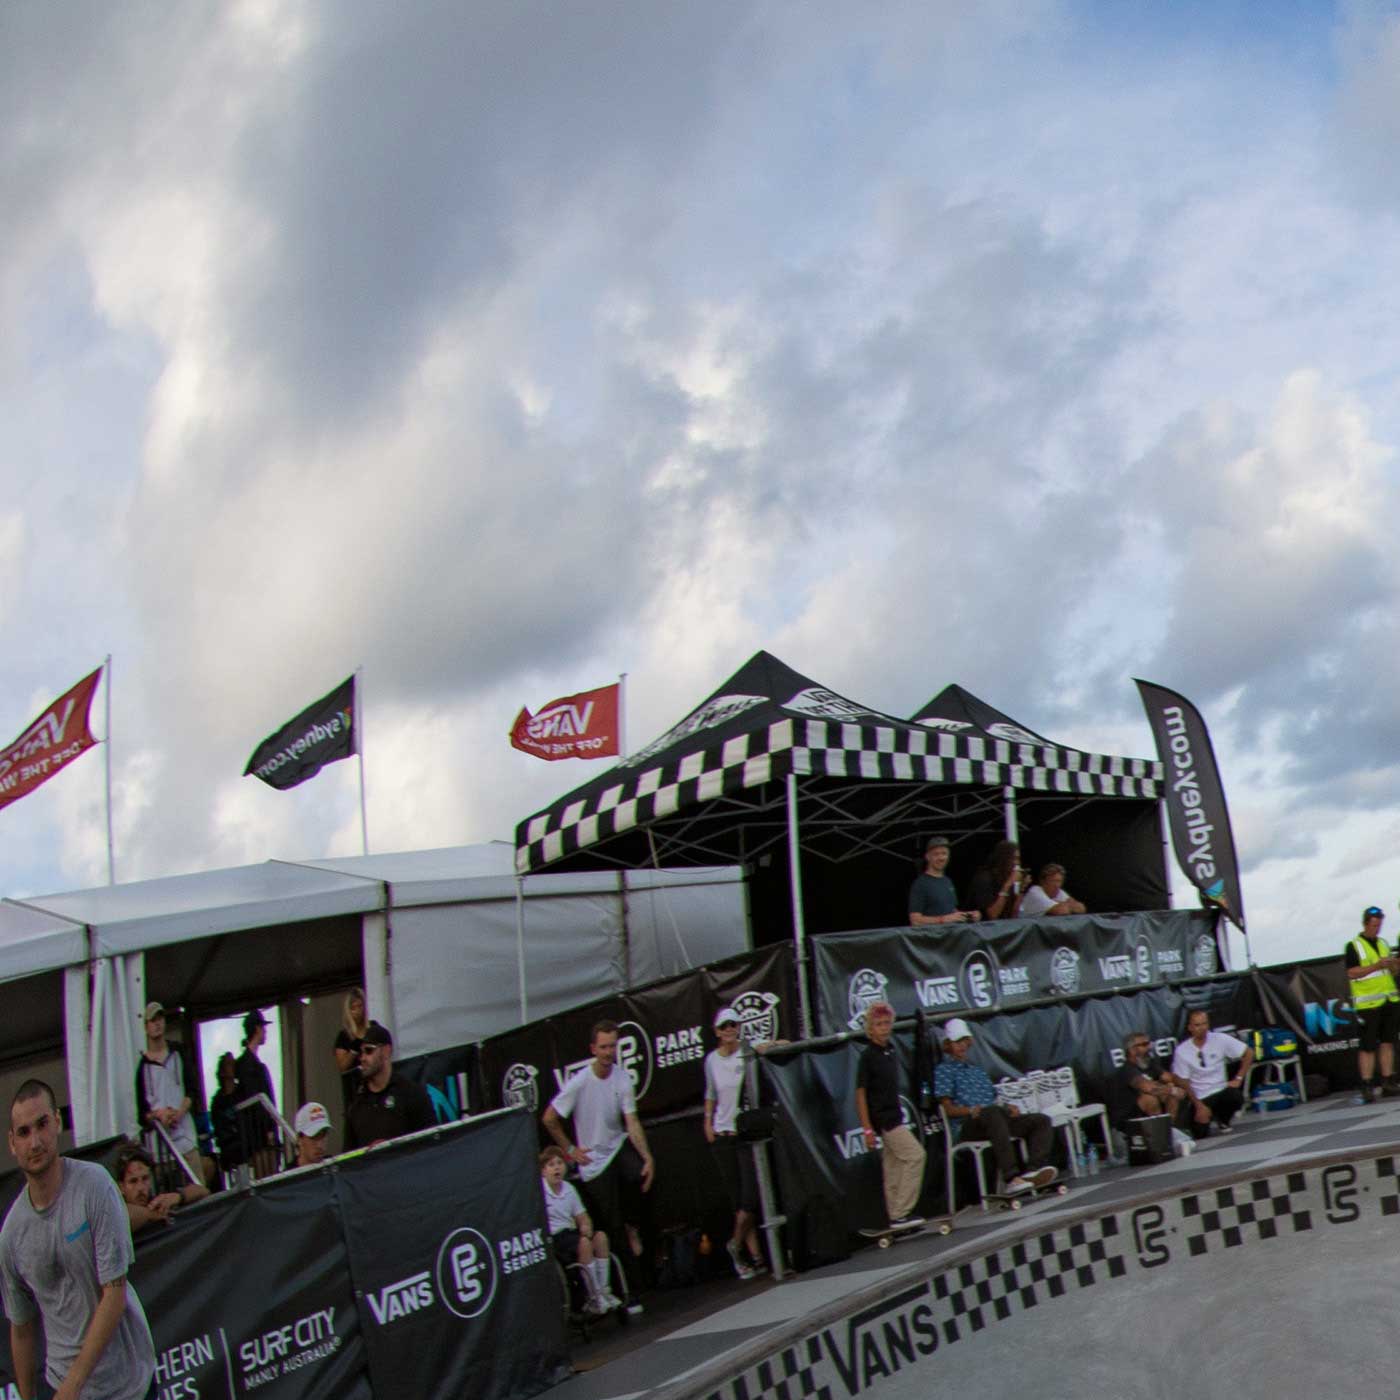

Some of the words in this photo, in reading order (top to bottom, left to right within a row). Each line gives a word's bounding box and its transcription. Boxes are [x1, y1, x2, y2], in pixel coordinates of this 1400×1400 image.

[915, 976, 960, 1008] VANS
[656, 1025, 704, 1054] PARK
[657, 1045, 705, 1069] SERIES
[366, 1270, 434, 1326] VANS
[498, 1228, 544, 1260] PARK
[503, 1246, 548, 1276] SERIES
[821, 1283, 941, 1396] VANS
[154, 1333, 214, 1385] HERN
